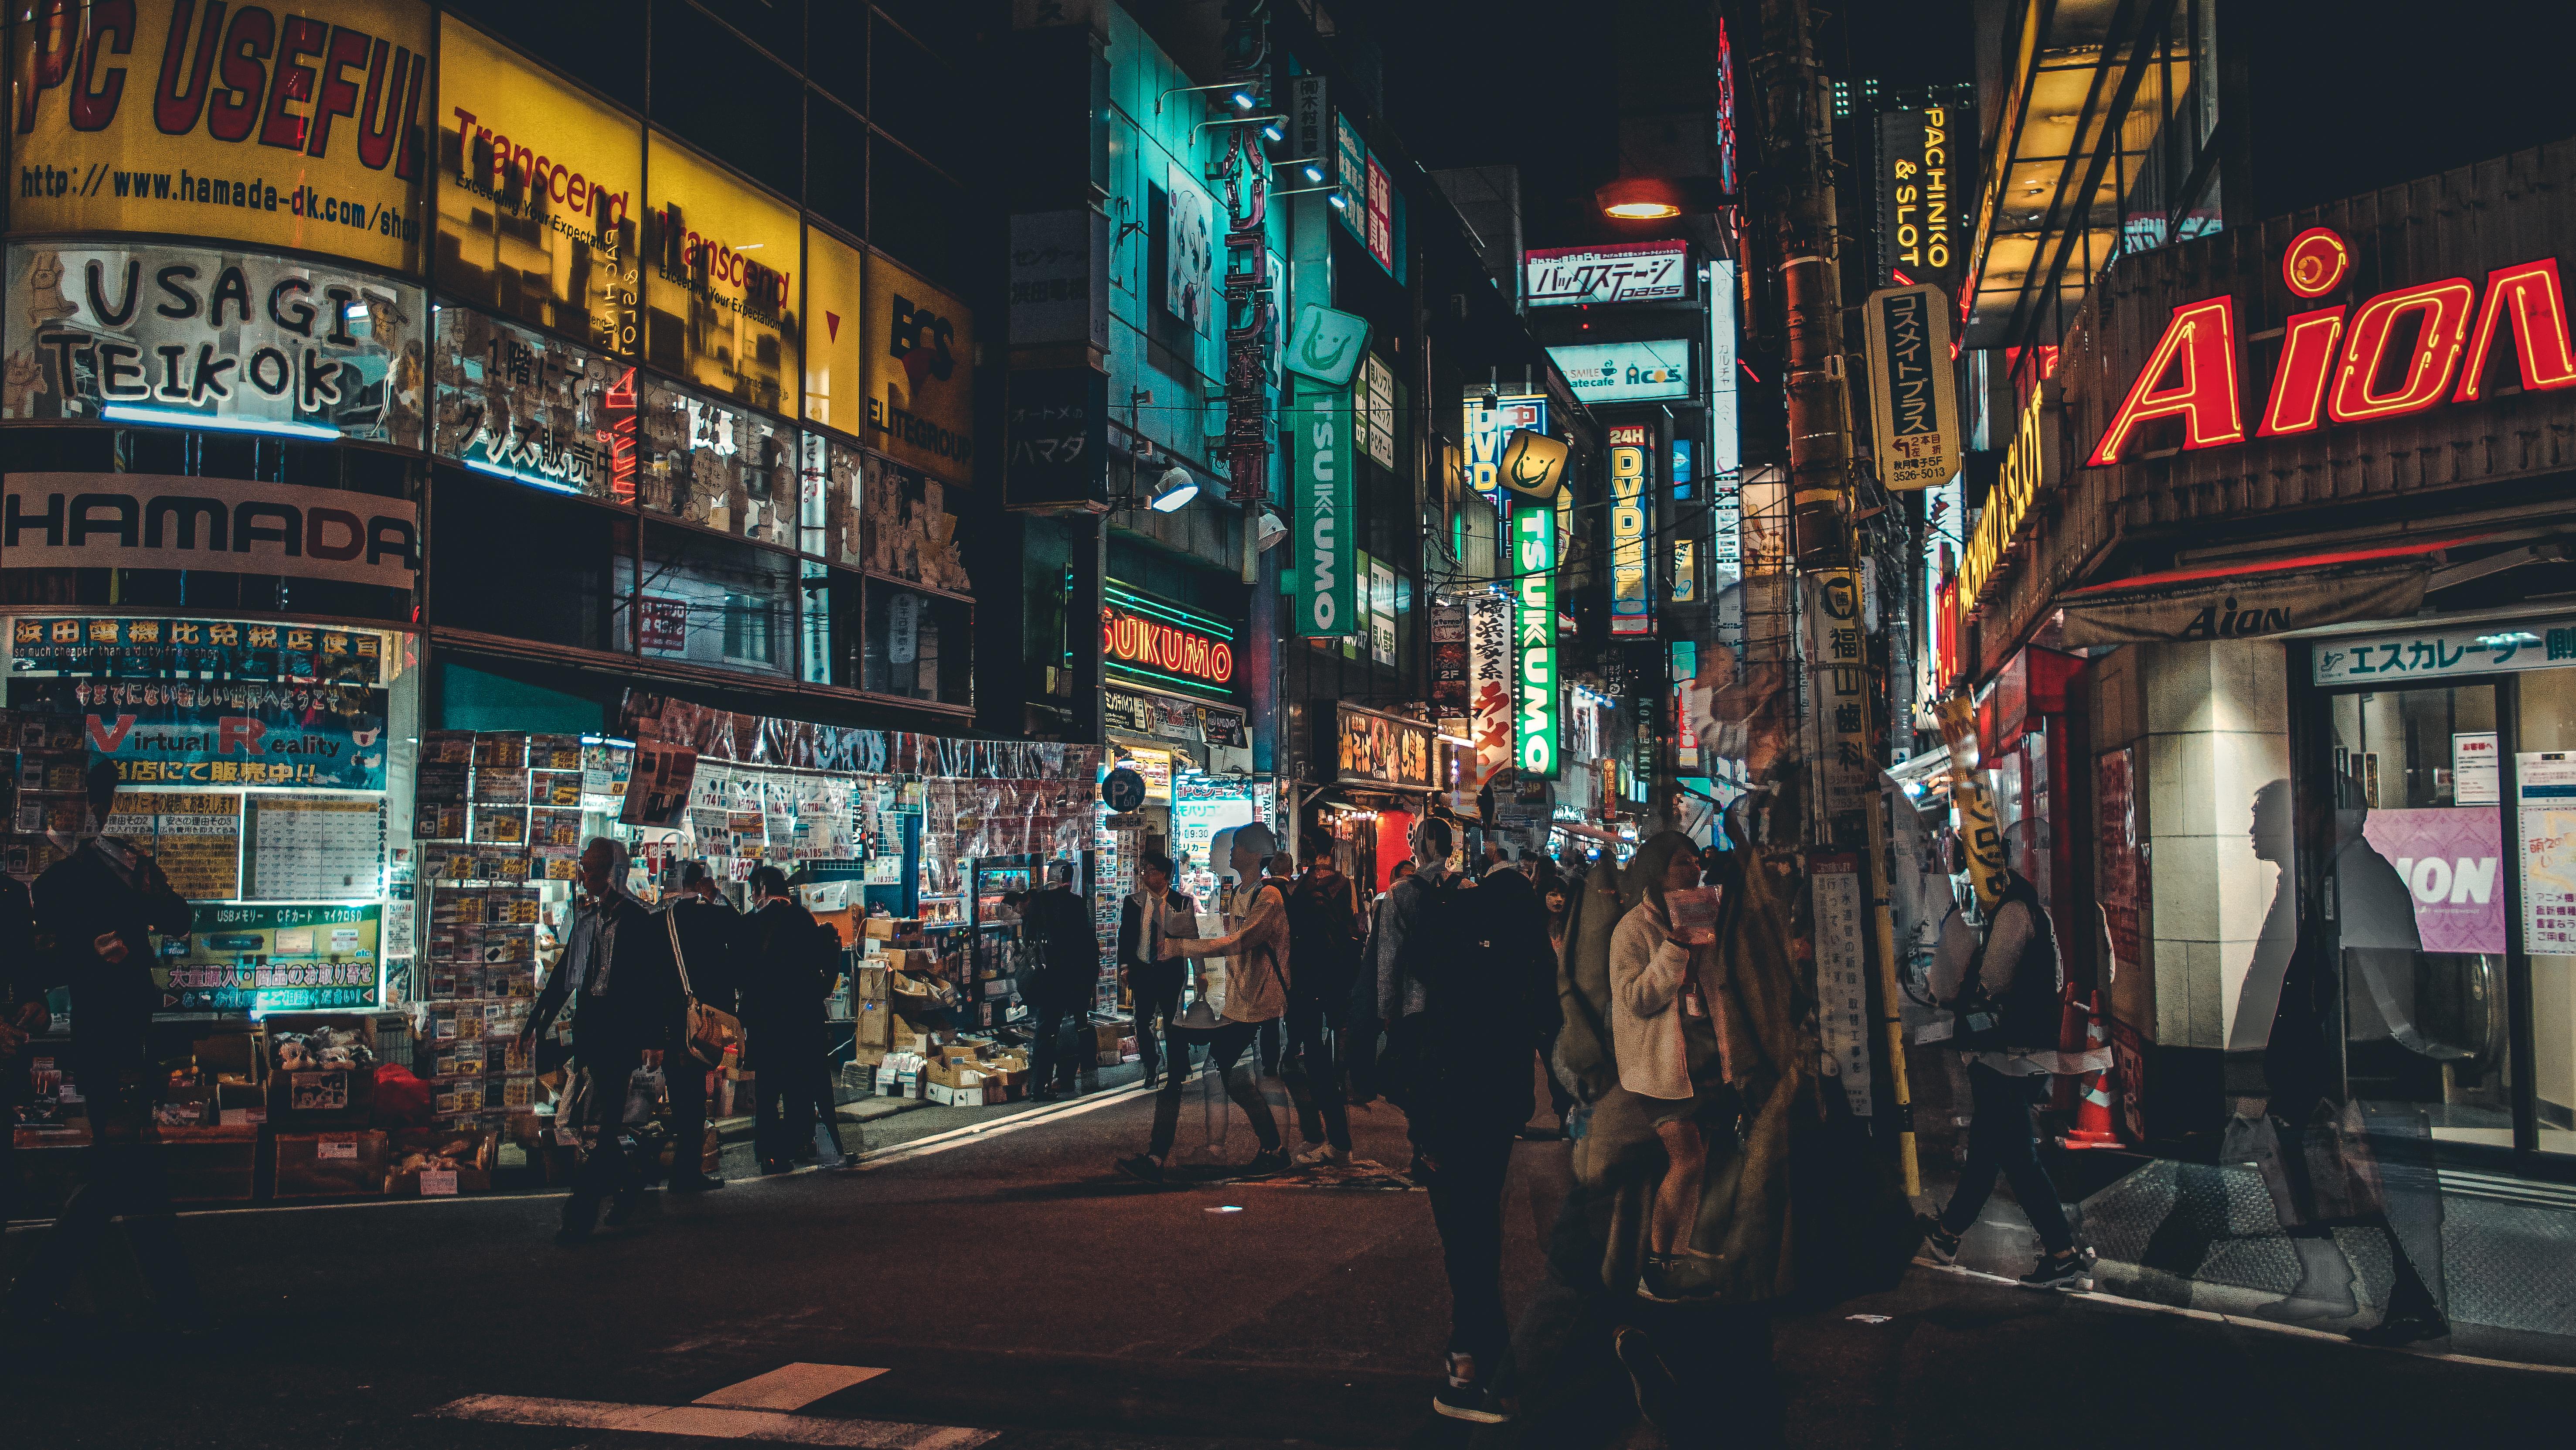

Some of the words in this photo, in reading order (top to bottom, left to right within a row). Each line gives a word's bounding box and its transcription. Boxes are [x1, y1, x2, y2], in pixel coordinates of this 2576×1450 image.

[17, 0, 136, 134] PC
[153, 0, 425, 186] USEFUL
[454, 106, 629, 230] Transcend
[1895, 158, 1917, 180] &
[1924, 106, 1949, 268] PACHINKO
[456, 173, 519, 215] Exceeding
[525, 199, 550, 225] Your
[1896, 184, 1919, 267] SLOT
[659, 210, 790, 309] Transcend
[1529, 258, 1676, 303] バックステージ
[87, 259, 357, 347] USAGI
[659, 266, 706, 301] Exceeding
[710, 284, 729, 307] Your
[1618, 285, 1681, 302] pass
[40, 333, 341, 407] TEIKOK
[1891, 295, 1929, 435] コスメイトプラス
[2086, 227, 2576, 467] Aion
[1570, 368, 1600, 379] SMILE
[1590, 377, 1614, 387] cafe
[460, 404, 613, 488] グッズ販売中
[868, 396, 973, 465] ELITEGROUP
[1011, 430, 1088, 466] ハマダ
[1472, 403, 1498, 491] DVD
[1610, 429, 1644, 444] 24H
[1893, 455, 1943, 471] 秋月電子5F
[1893, 466, 1945, 482] 3526-5013
[4, 493, 416, 570] HAMADA
[1313, 394, 1335, 629] TSUKUMO
[14, 648, 24, 657] so
[28, 646, 51, 657] much
[54, 647, 94, 658] cheaper
[99, 646, 121, 657] than
[133, 646, 160, 658] duty
[165, 646, 189, 658] free
[194, 647, 219, 660] shop
[1521, 509, 1549, 774] TSUKUMO
[1441, 670, 1459, 679] 2F
[1831, 628, 1864, 772] 福山歯科
[87, 714, 211, 753] Virtual
[218, 715, 342, 758] Reality
[1113, 780, 1128, 807] P
[1263, 795, 1271, 812] TAX
[217, 909, 264, 923] USBメモリー
[277, 909, 313, 923] CFカード
[323, 908, 362, 921] マイクロSD
[170, 964, 373, 989] 大量購入・商品のお取り寄せ
